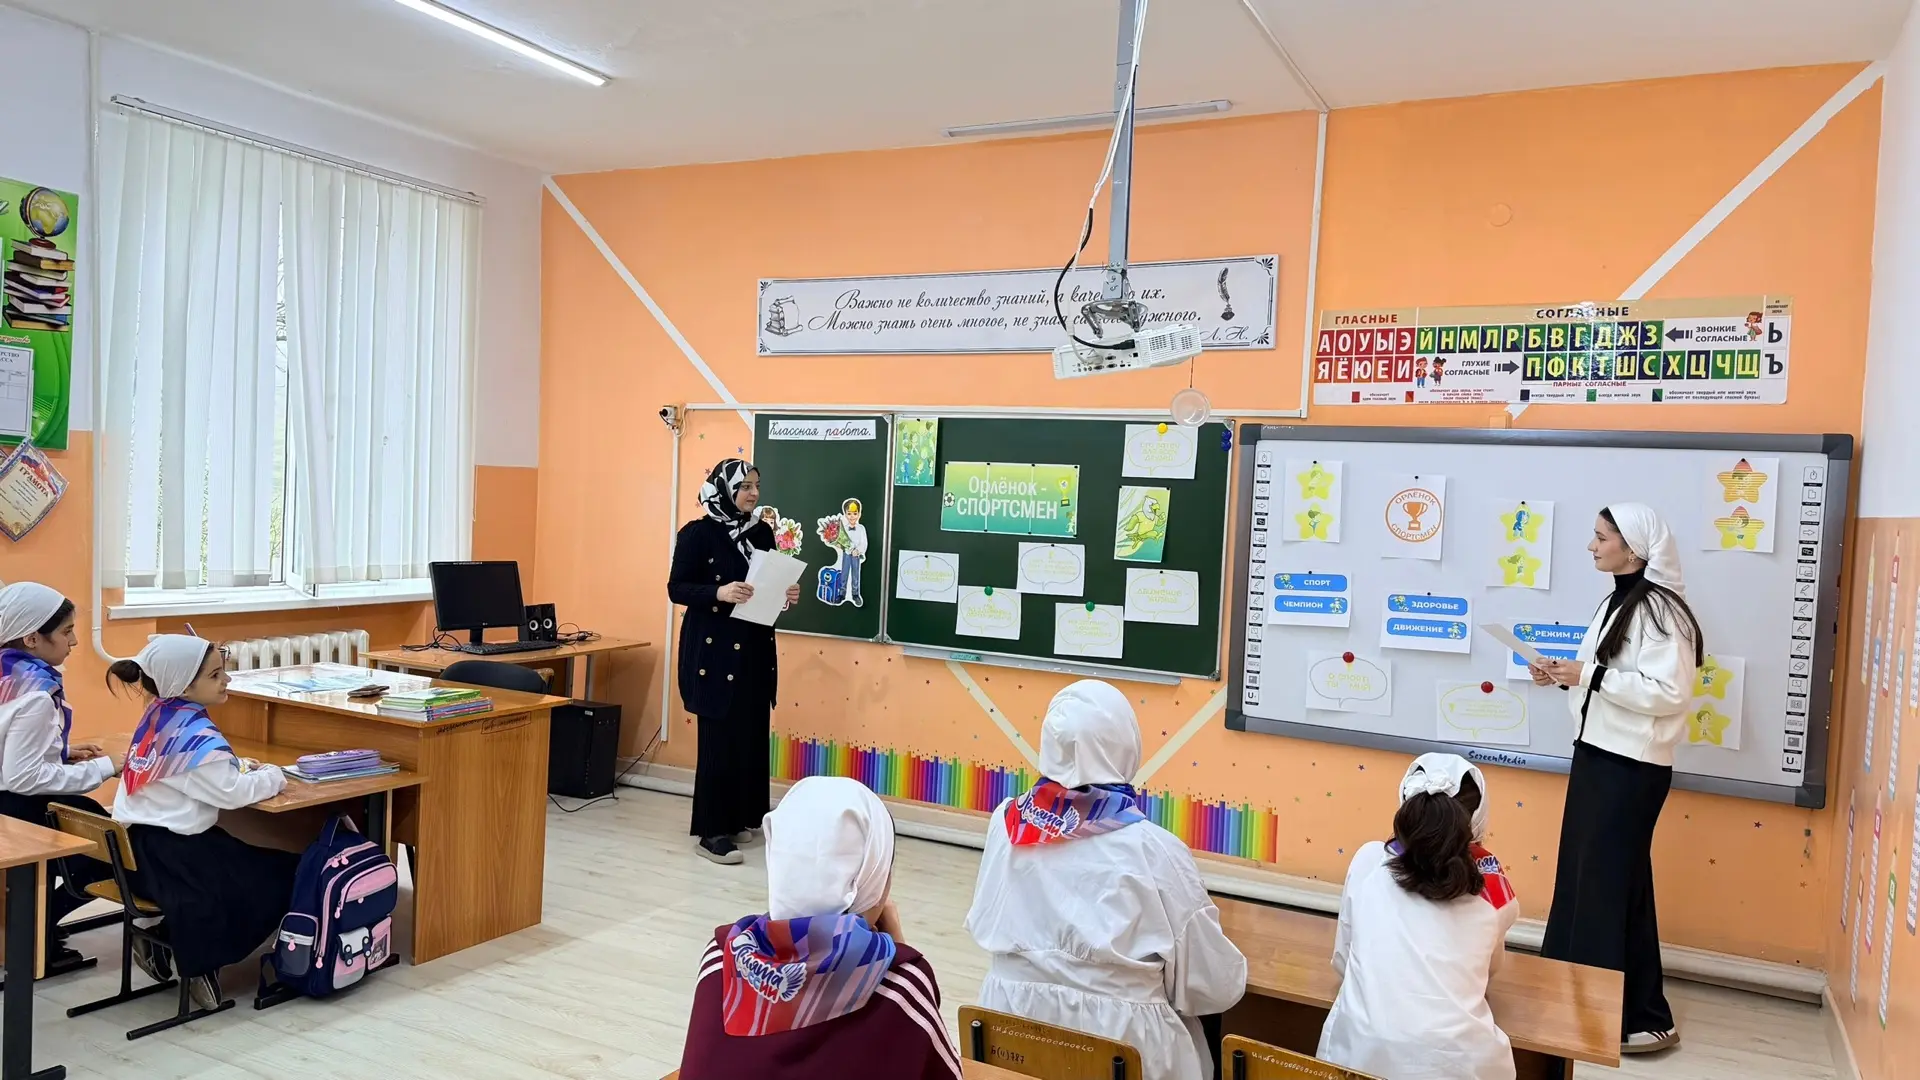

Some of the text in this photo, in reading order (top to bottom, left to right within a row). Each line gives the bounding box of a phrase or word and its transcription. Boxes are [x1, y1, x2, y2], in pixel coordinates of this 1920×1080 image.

[835, 289, 893, 309] Важно
[897, 298, 911, 308] не
[916, 288, 991, 307] количество
[992, 289, 1049, 311] знаний,
[1071, 285, 1135, 302] качео
[1141, 289, 1165, 299] их.
[1335, 314, 1398, 325] ГЛАСНЫЕ
[1536, 307, 1629, 319] СОГЛАНЫЕ
[808, 310, 873, 331] Можно
[874, 318, 916, 335] знать
[920, 317, 953, 329] очень
[957, 317, 1007, 330] многое,
[1013, 316, 1029, 327] не
[1138, 311, 1201, 328] ужного.
[1696, 325, 1737, 333] ЗВОНКИЕ
[769, 421, 871, 440] Классная работа.
[19, 466, 49, 498] ГРАМОТА
[968, 475, 1037, 497] Орлёнок
[957, 497, 1058, 519] СПОРТСМЕН
[1391, 523, 1437, 540] СПОРТСМЕН
[1304, 579, 1331, 587] СПОРТ
[1283, 600, 1323, 608] ЧЕМПИОН
[1411, 601, 1459, 610] ЗДОРОВЬЕ
[1393, 624, 1443, 633] ДВИЖЕНИЕ
[1535, 630, 1585, 640] РЕЖИМ ДН
[1468, 750, 1526, 766] ScreenMedia
